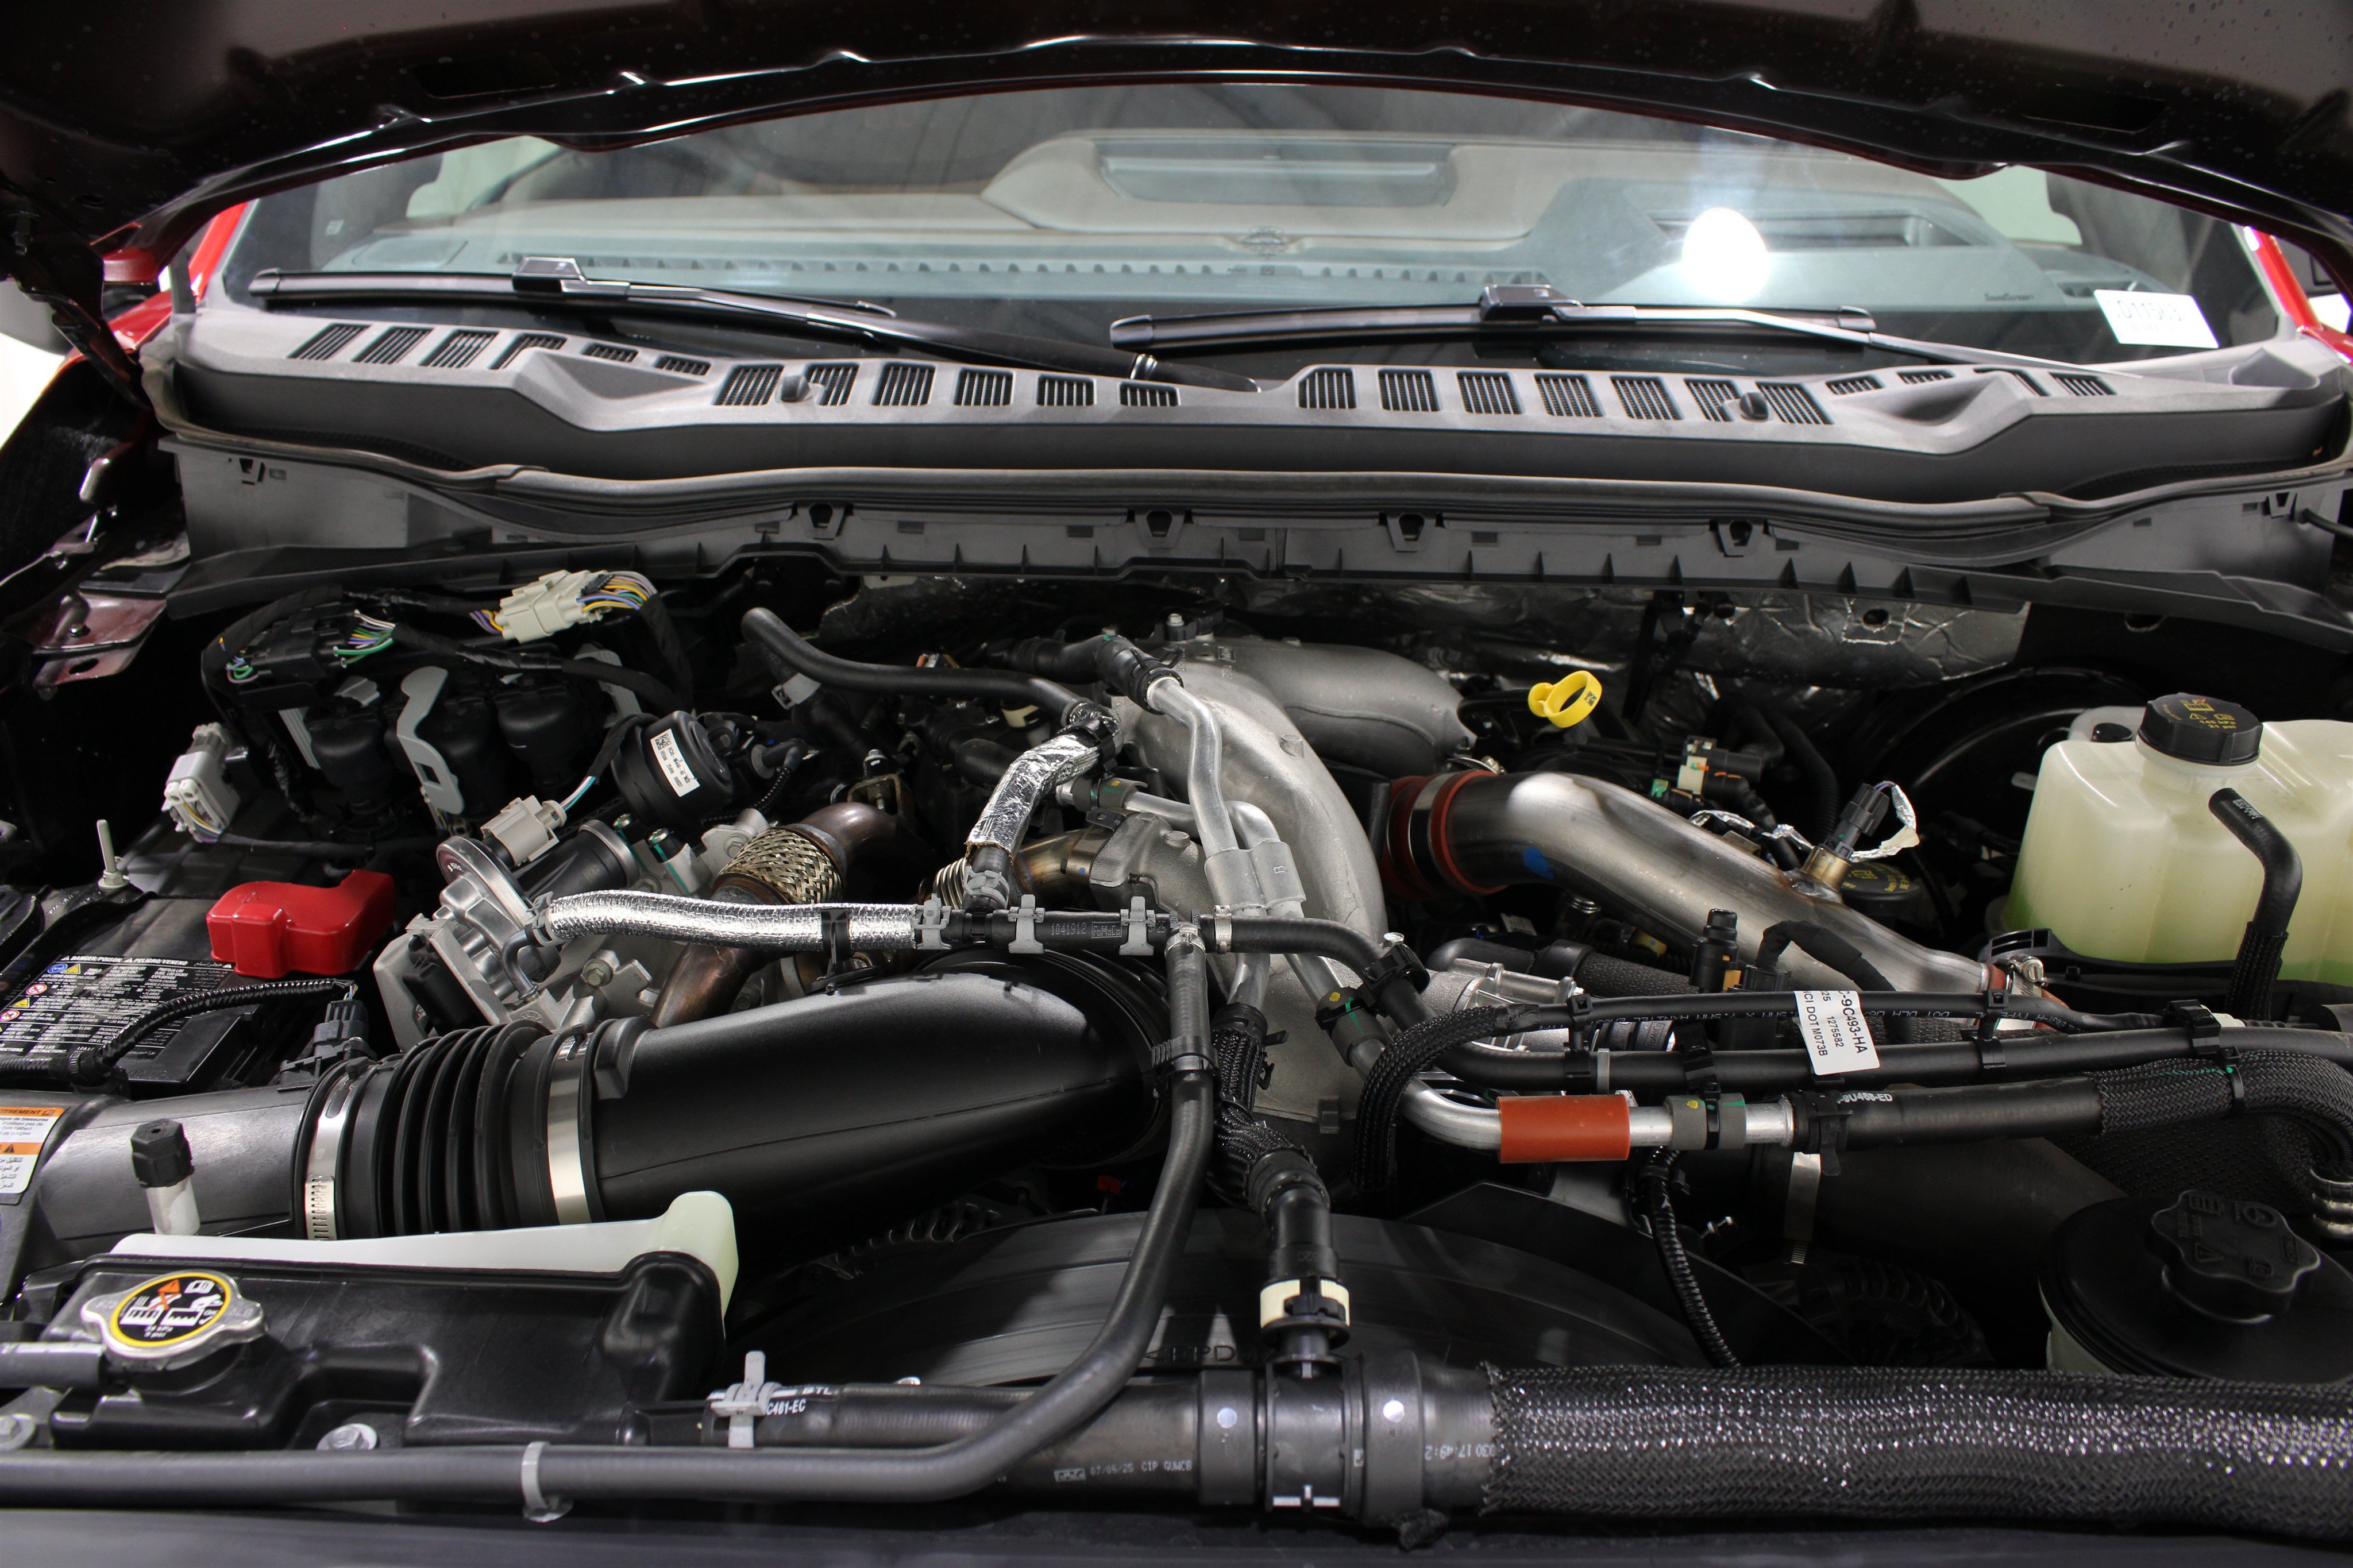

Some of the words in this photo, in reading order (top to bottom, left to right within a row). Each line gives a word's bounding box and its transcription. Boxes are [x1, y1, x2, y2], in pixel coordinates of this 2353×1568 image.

[1806, 1006, 1819, 1026] DOT
[1811, 1028, 1828, 1056] M073B
[1826, 1016, 1845, 1048] 1275582
